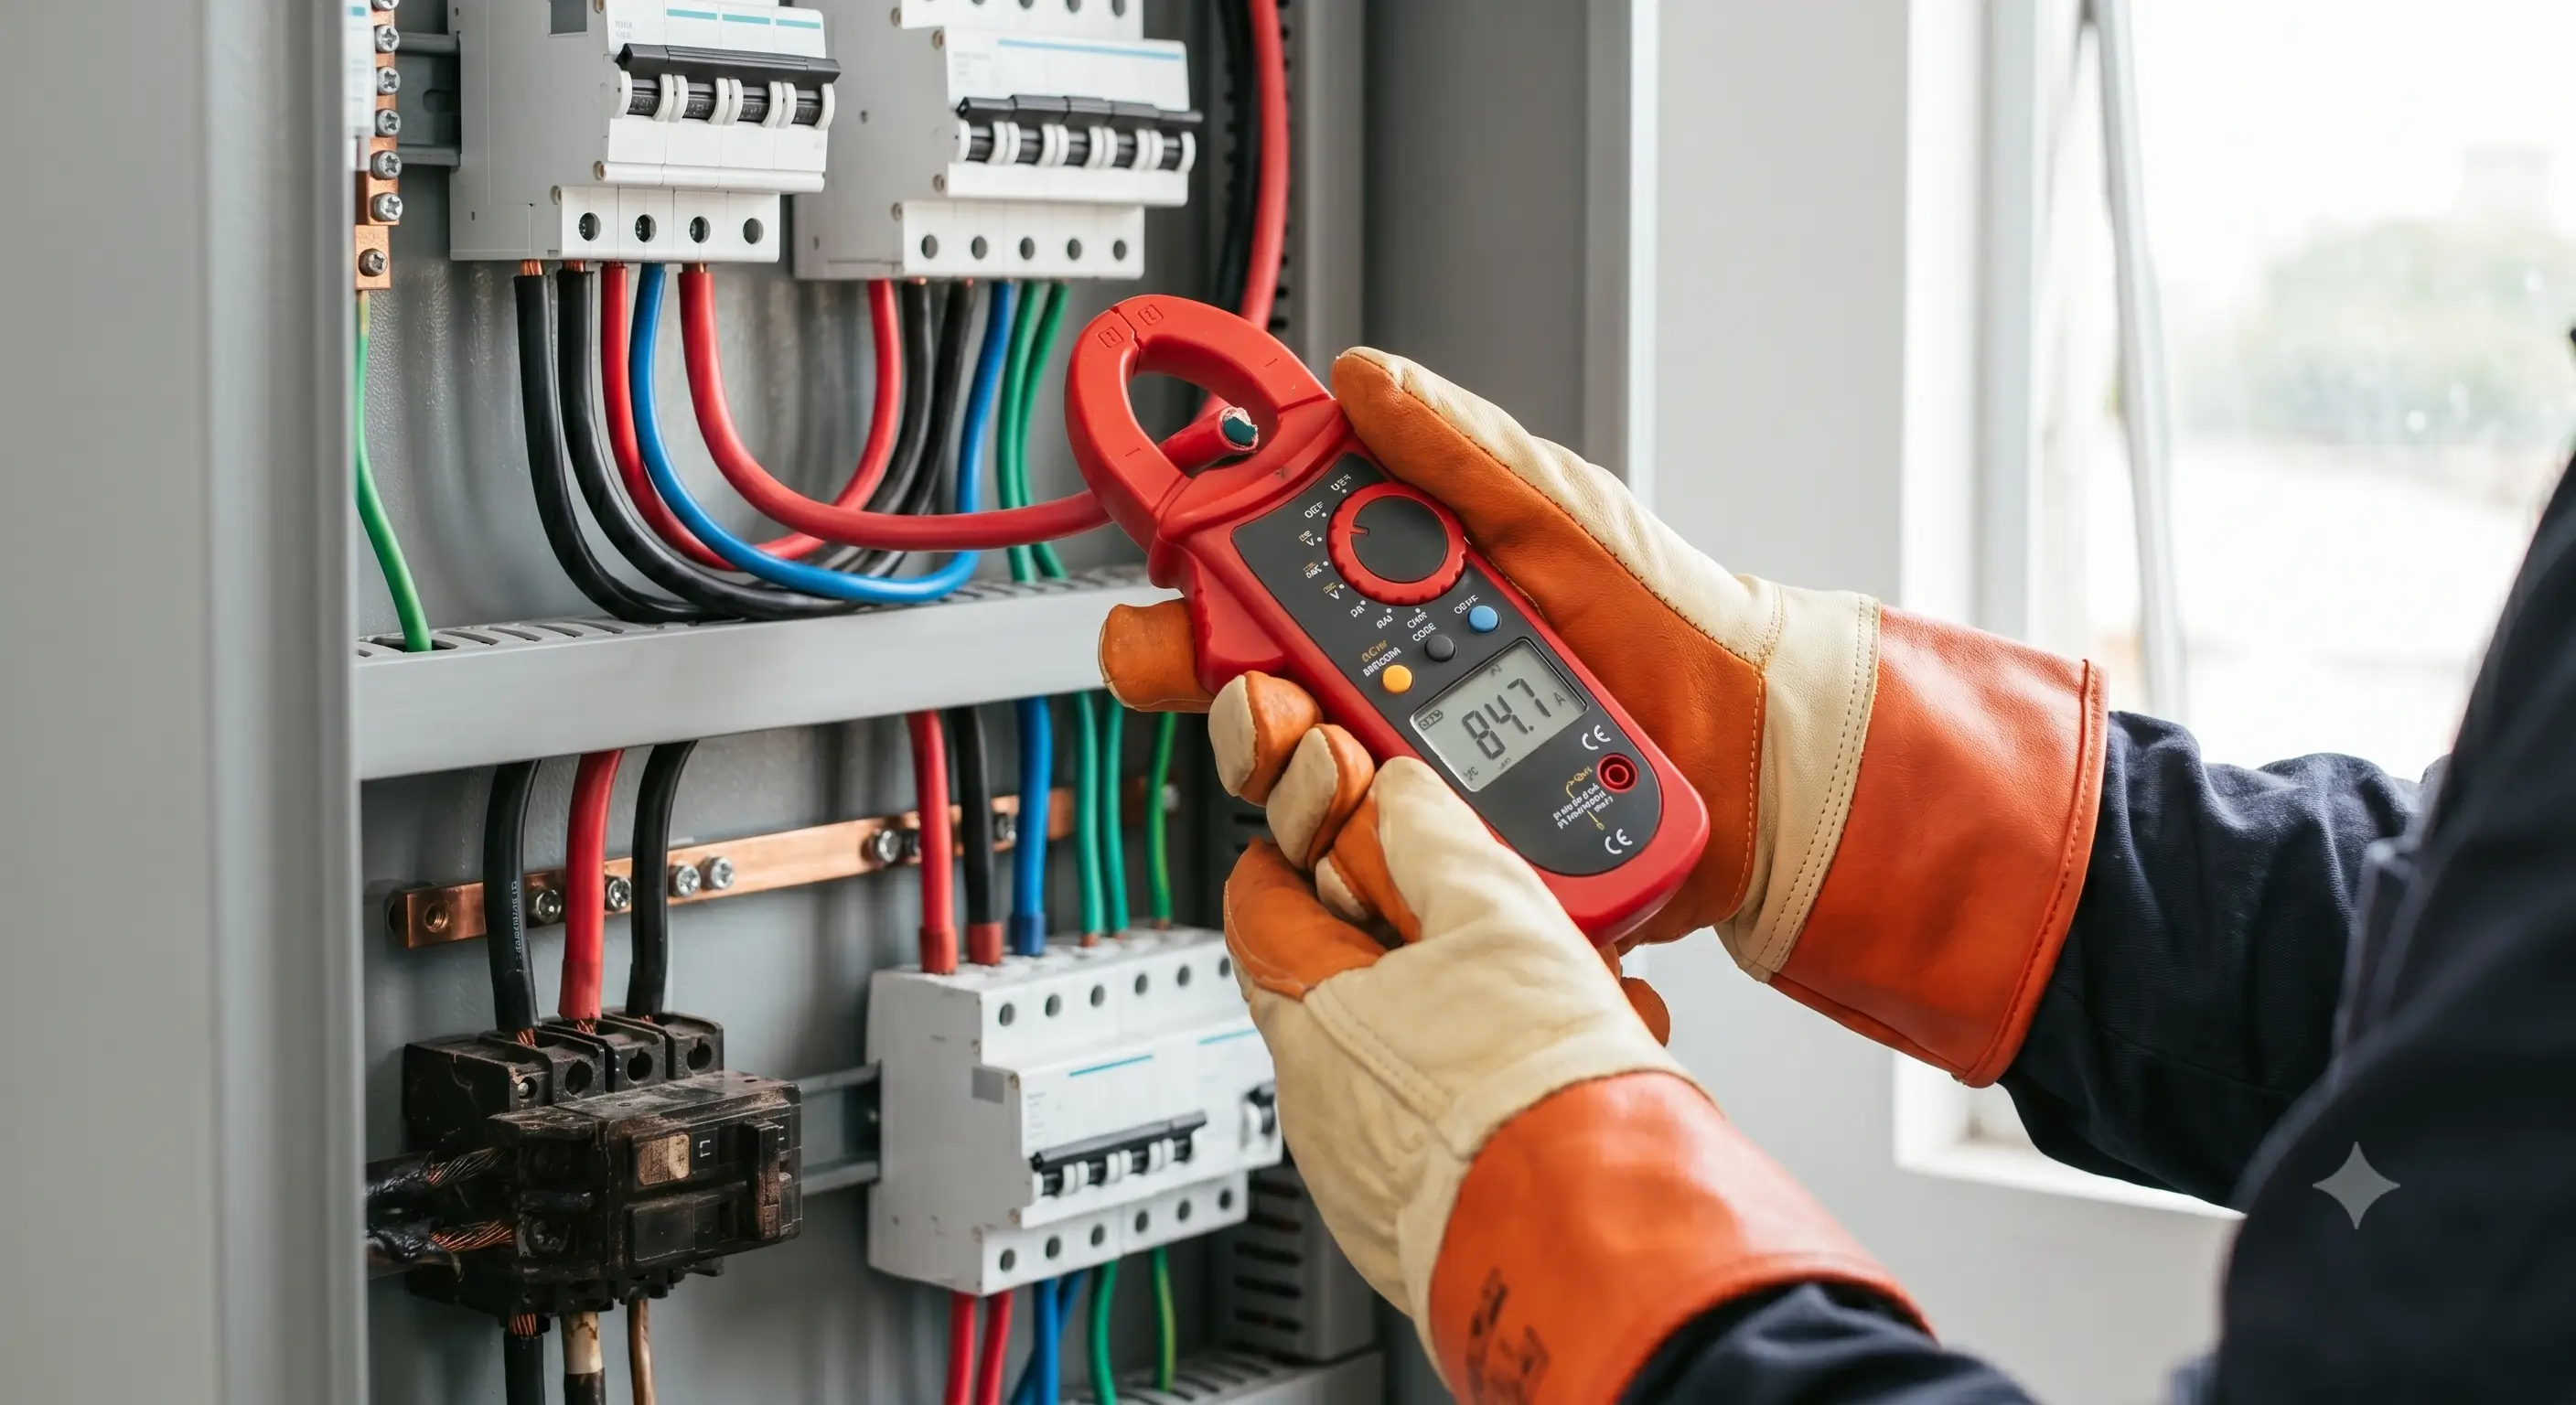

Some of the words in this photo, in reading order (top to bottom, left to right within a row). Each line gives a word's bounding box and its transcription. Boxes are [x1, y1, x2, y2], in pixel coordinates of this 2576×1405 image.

[1462, 678, 1551, 760] 84.7
[1582, 724, 1611, 750] CE
[1605, 828, 1633, 854] CE
